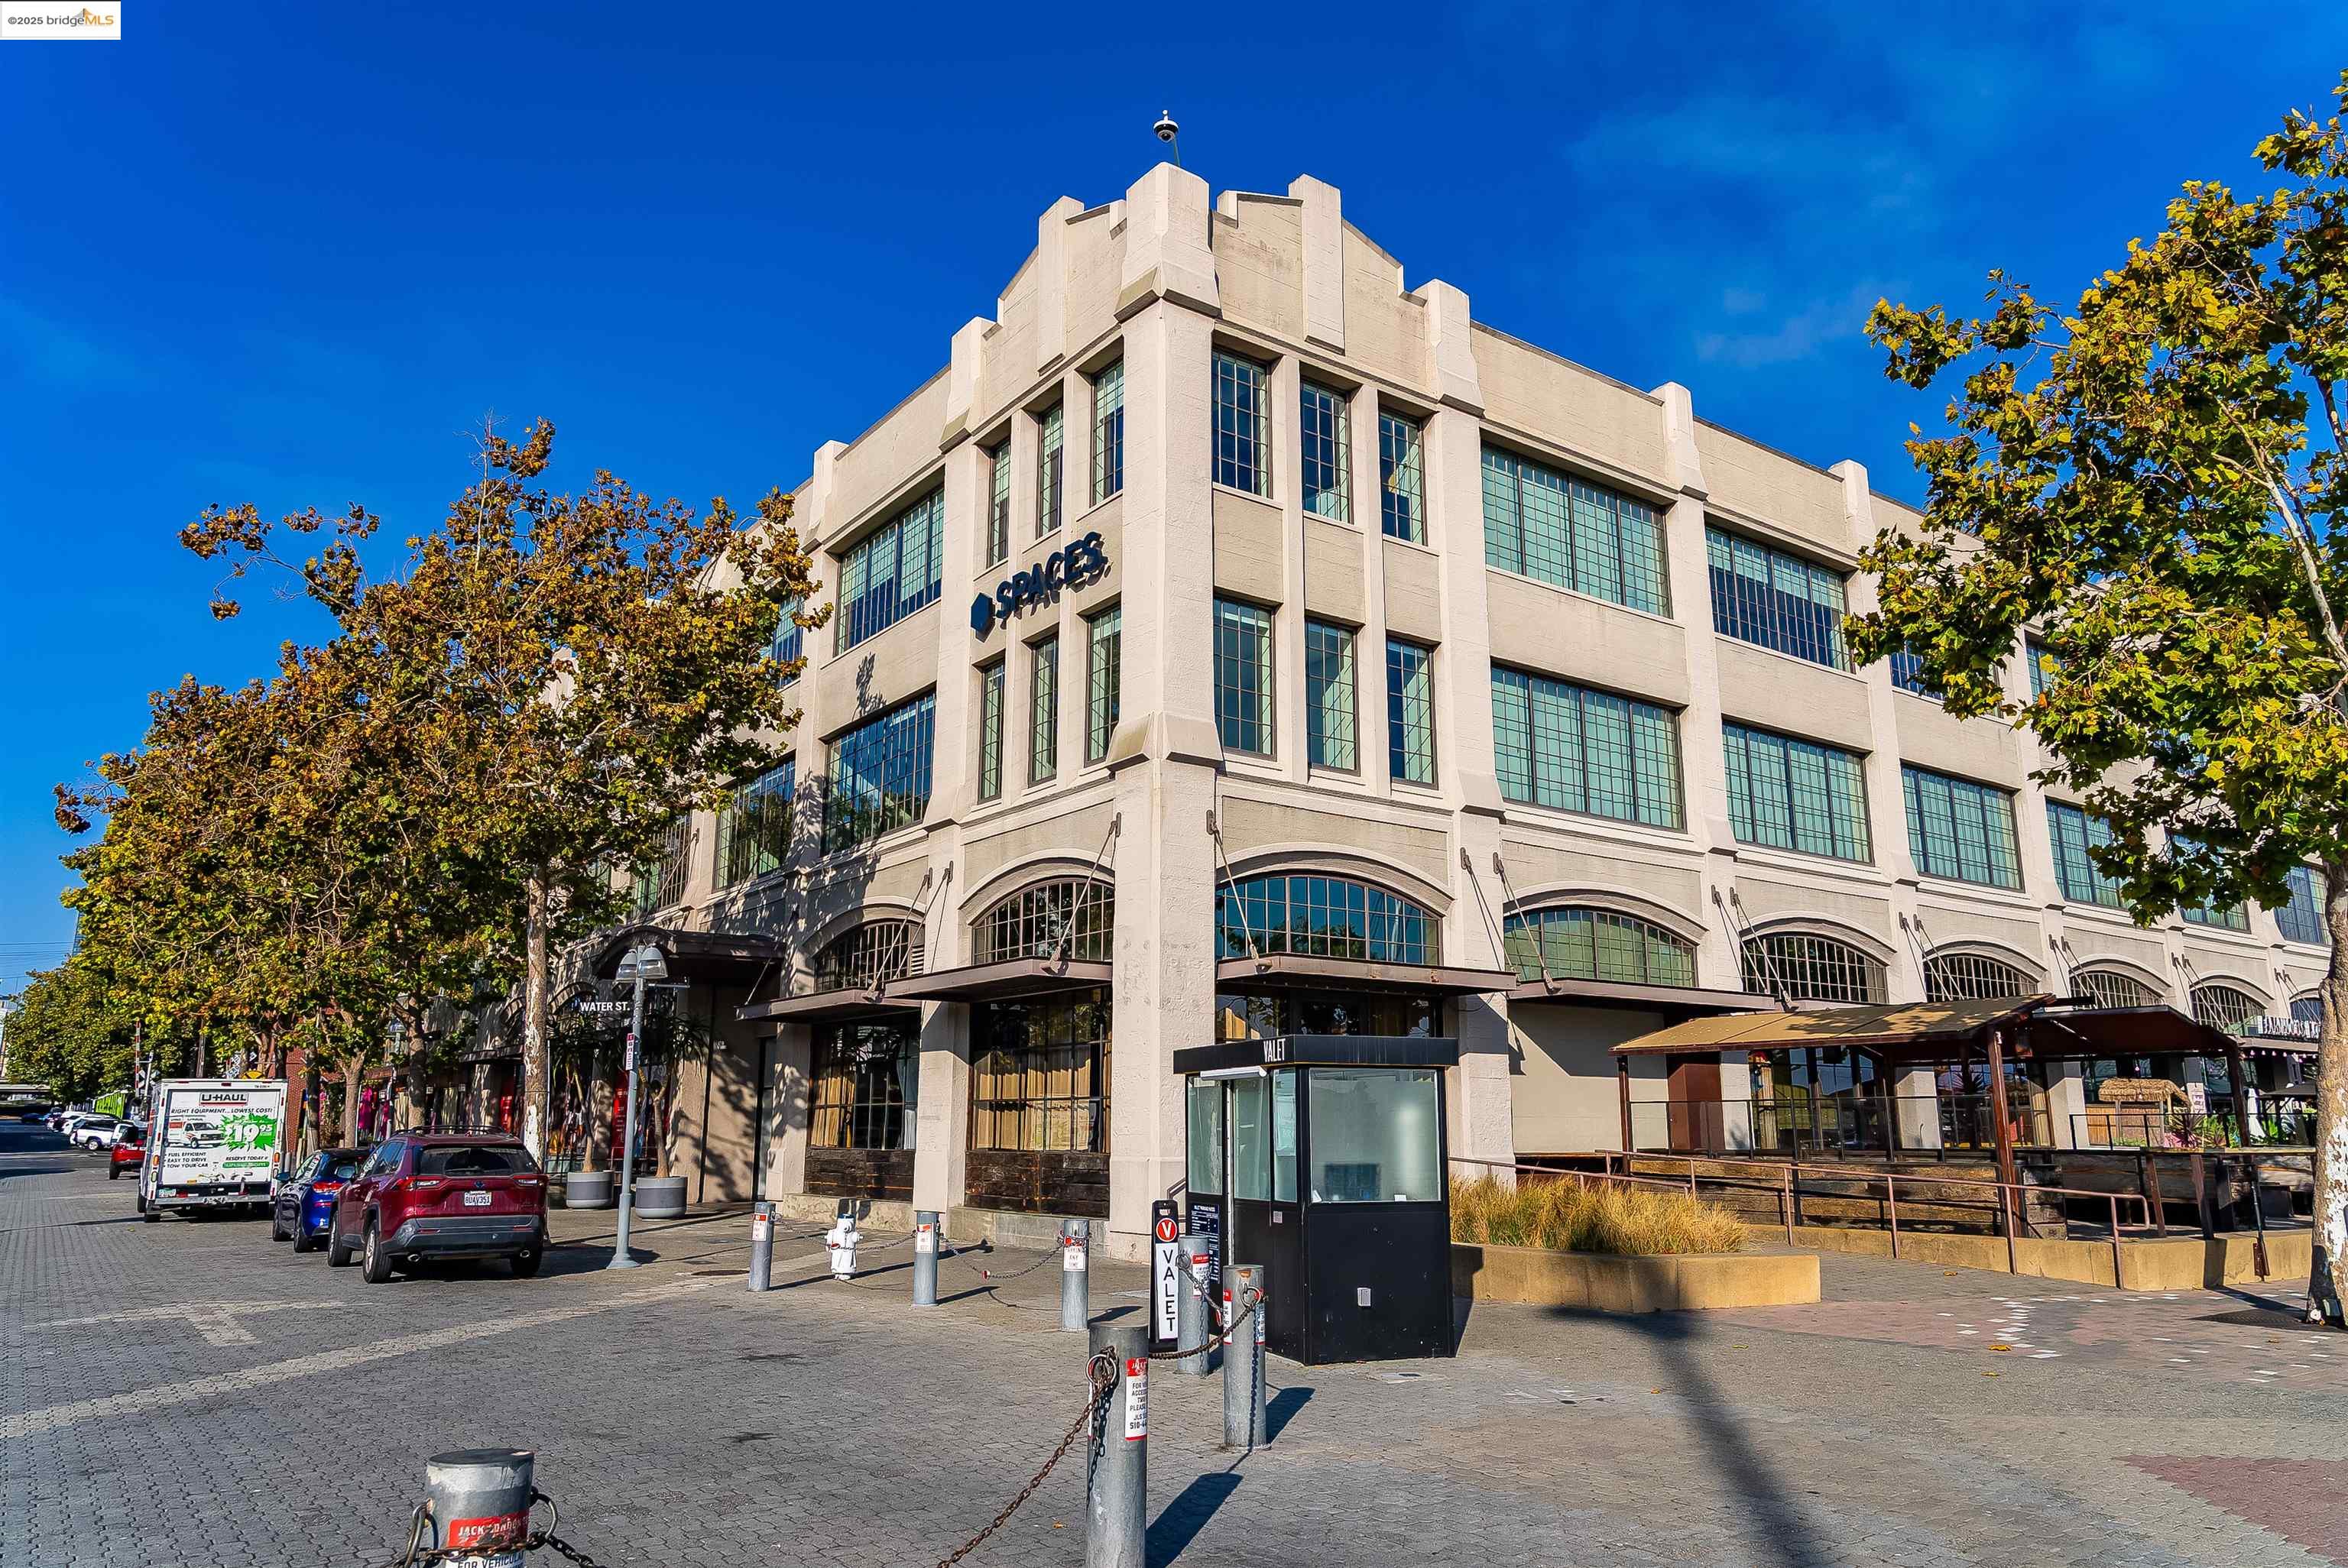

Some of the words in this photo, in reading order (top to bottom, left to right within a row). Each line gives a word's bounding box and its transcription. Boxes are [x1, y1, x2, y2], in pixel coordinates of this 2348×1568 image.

[579, 1002, 613, 1012] WATER
[615, 1001, 631, 1011] ST.
[1263, 1038, 1286, 1063] VALET
[1161, 1221, 1172, 1238] V
[1163, 1249, 1176, 1332] VALET
[458, 1524, 485, 1537] JACK
